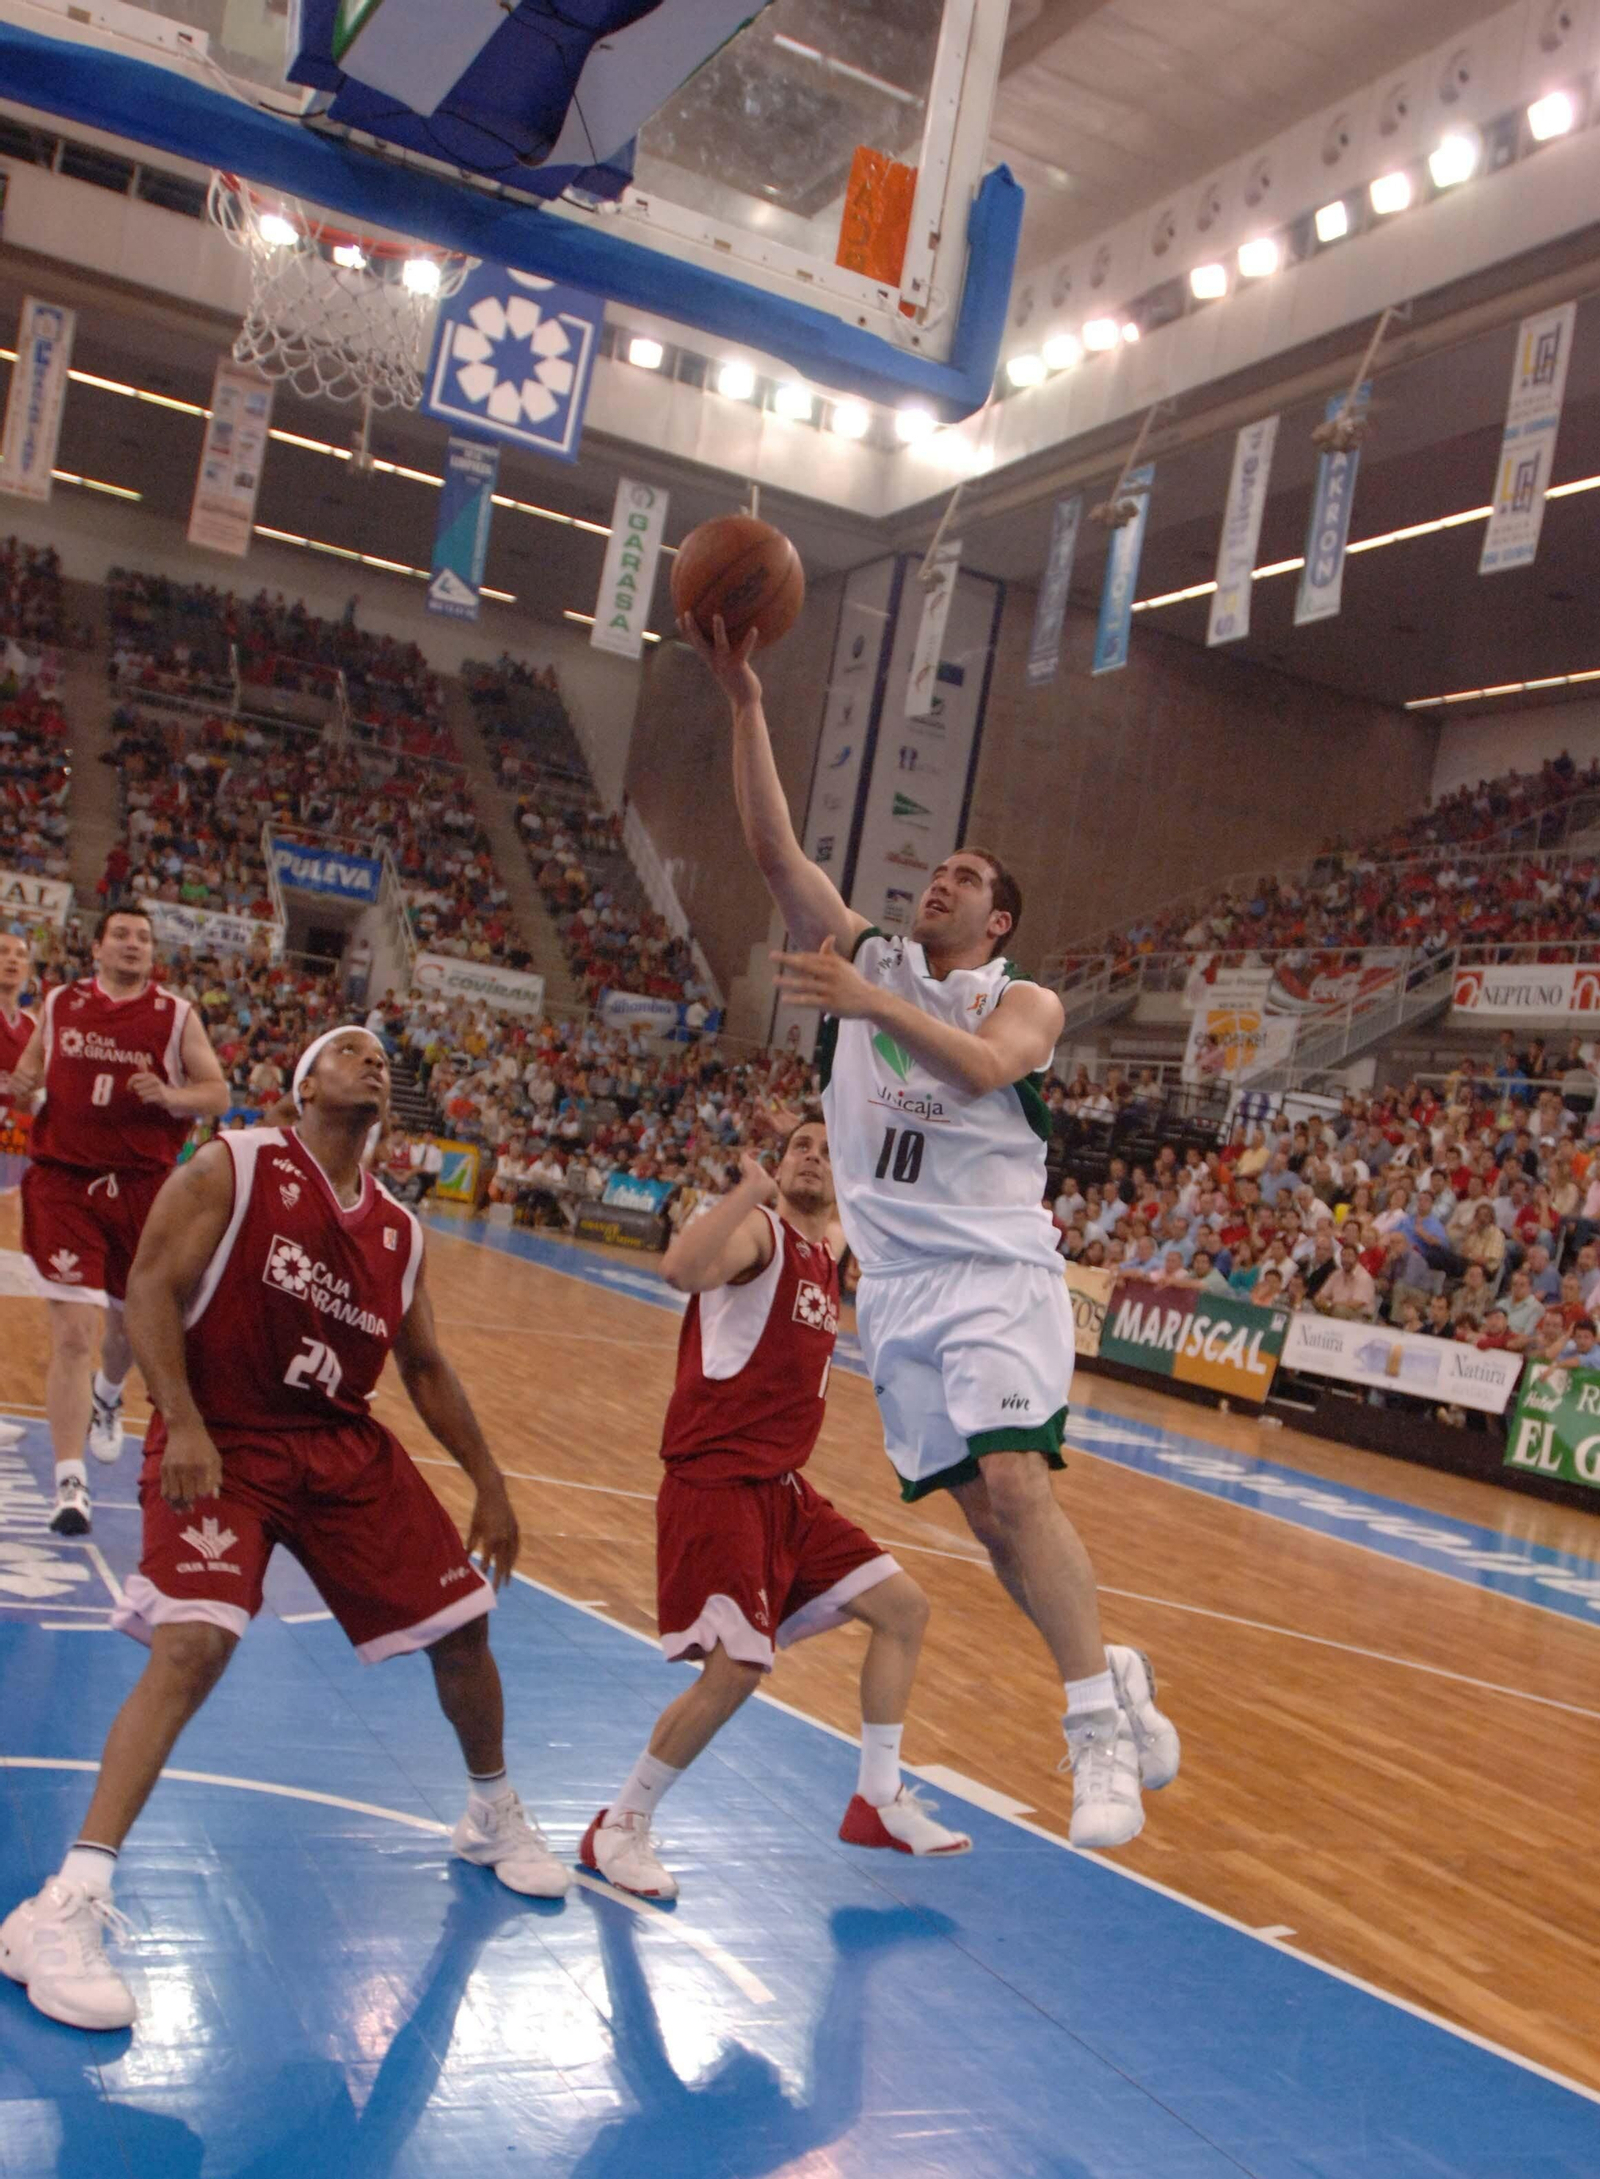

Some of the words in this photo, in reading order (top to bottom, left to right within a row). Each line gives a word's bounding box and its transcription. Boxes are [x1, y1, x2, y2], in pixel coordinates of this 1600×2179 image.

[609, 511, 649, 633] GARASA
[275, 850, 373, 892] PULEVA
[1484, 984, 1563, 1007] NEPTUNO
[91, 1073, 114, 1107] 8
[875, 1126, 925, 1185] 10
[311, 1260, 351, 1299] CAJA
[1112, 1298, 1267, 1375] MARISCAL
[282, 1335, 343, 1398] 24
[1513, 1417, 1562, 1472] EL
